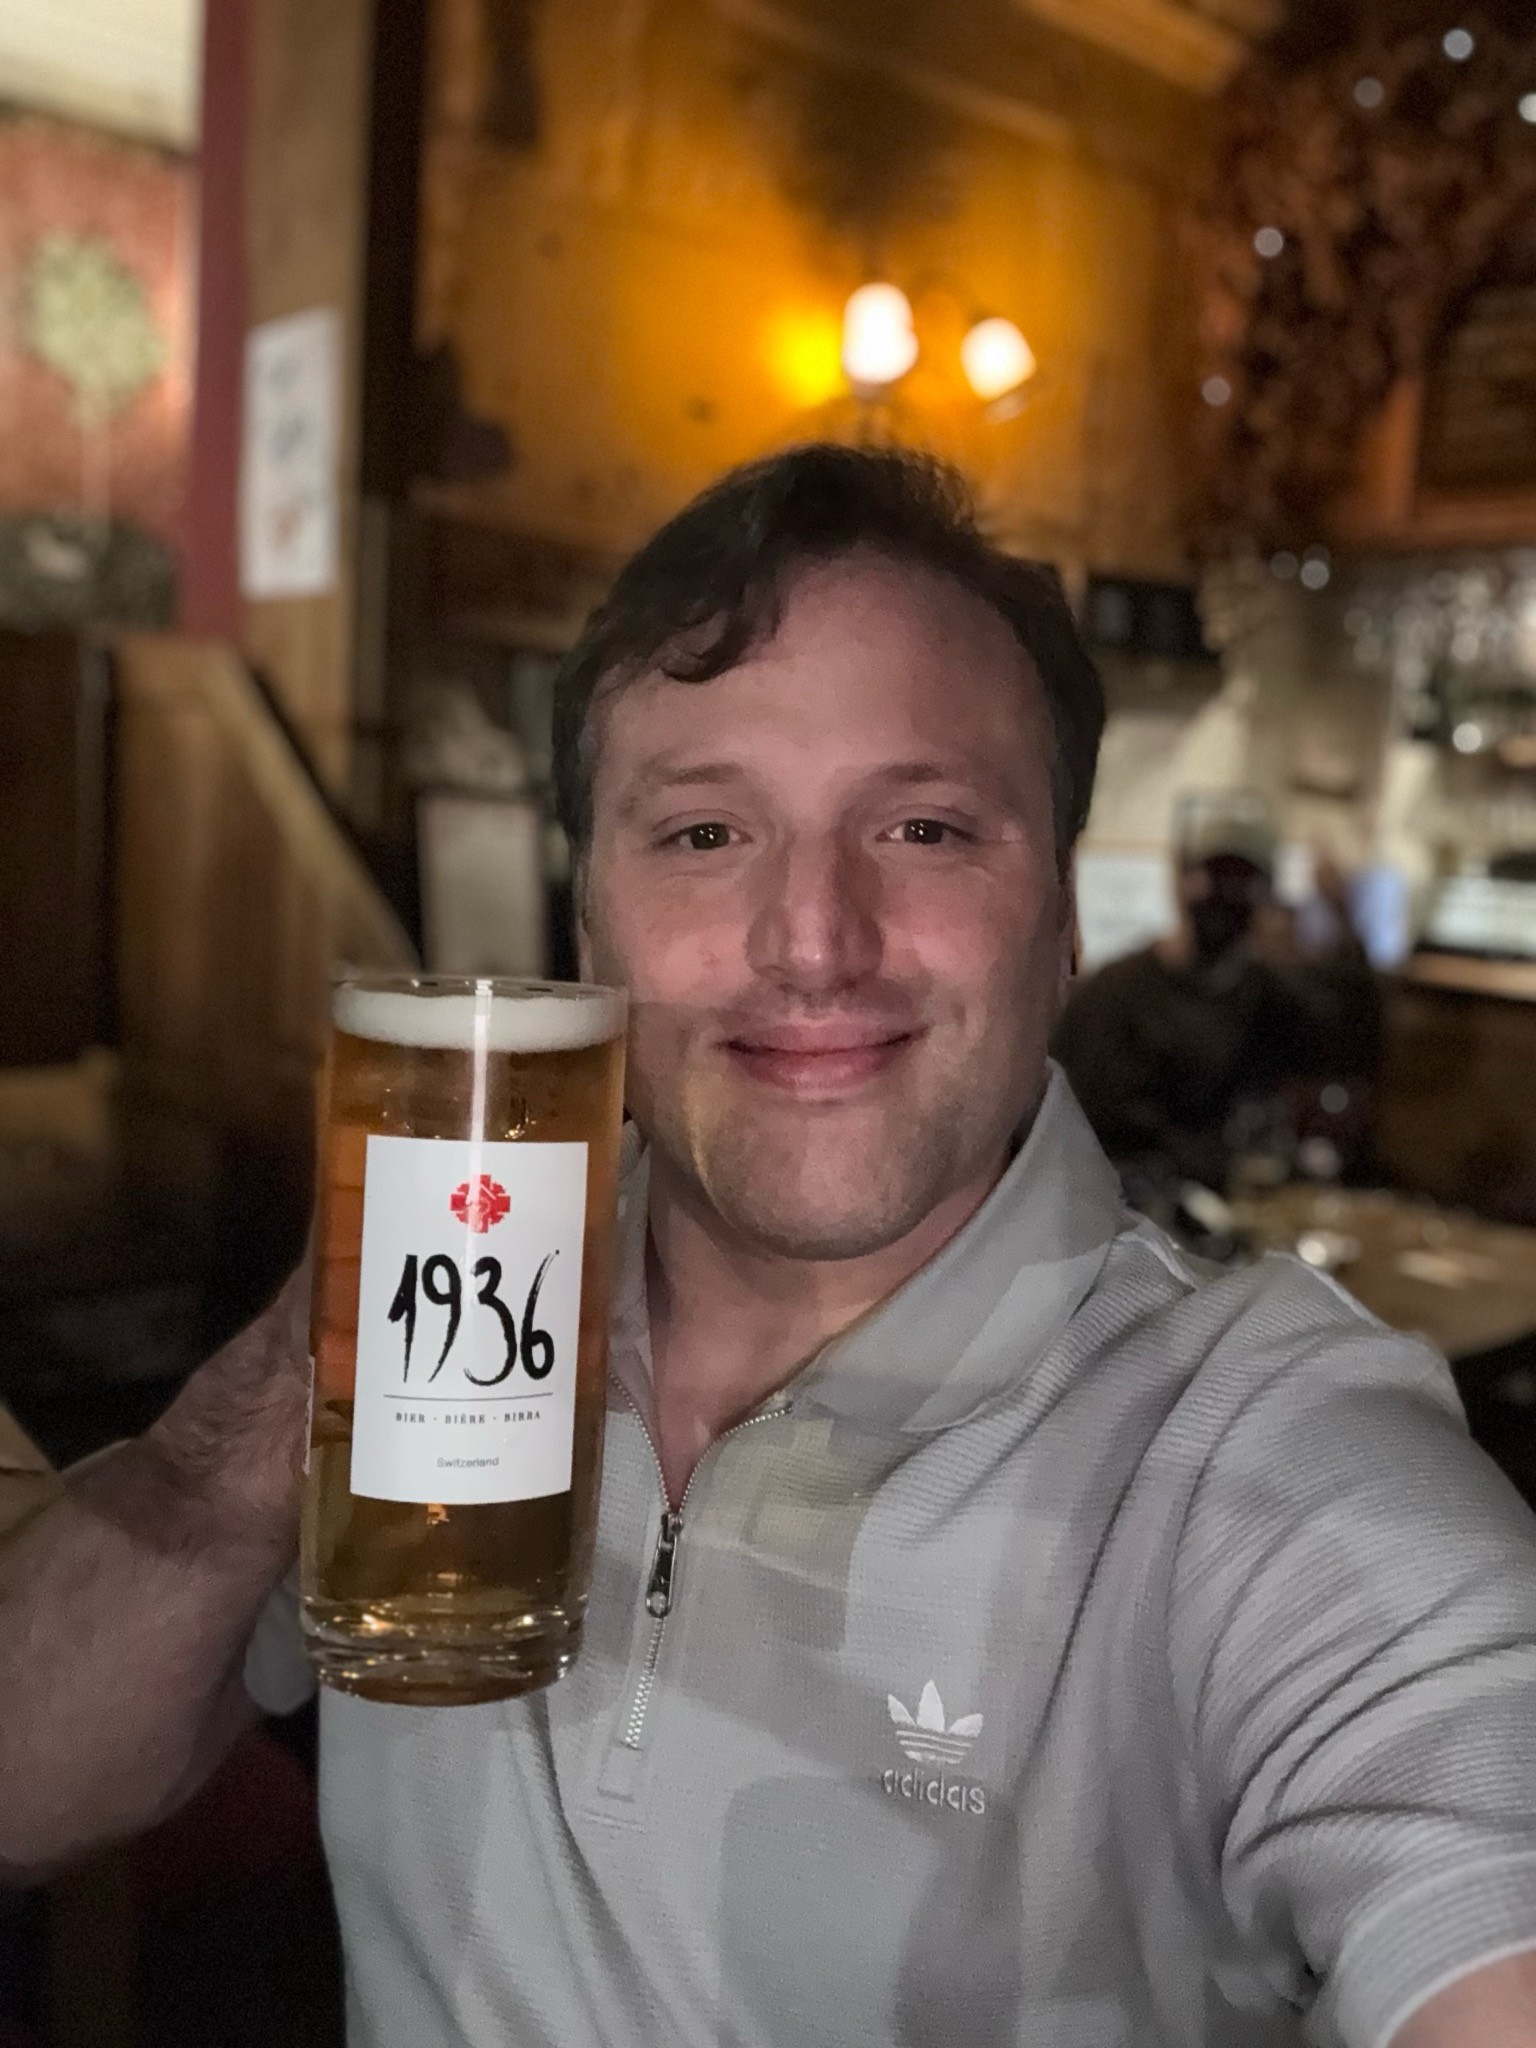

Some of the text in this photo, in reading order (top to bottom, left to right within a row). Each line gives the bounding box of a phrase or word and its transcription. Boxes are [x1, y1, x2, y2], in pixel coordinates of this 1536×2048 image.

[387, 1249, 560, 1387] 1936
[396, 1412, 426, 1424] BIER
[504, 1410, 541, 1423] BIRRA
[436, 1457, 500, 1468] Switzerland
[883, 1767, 985, 1814] adidas
